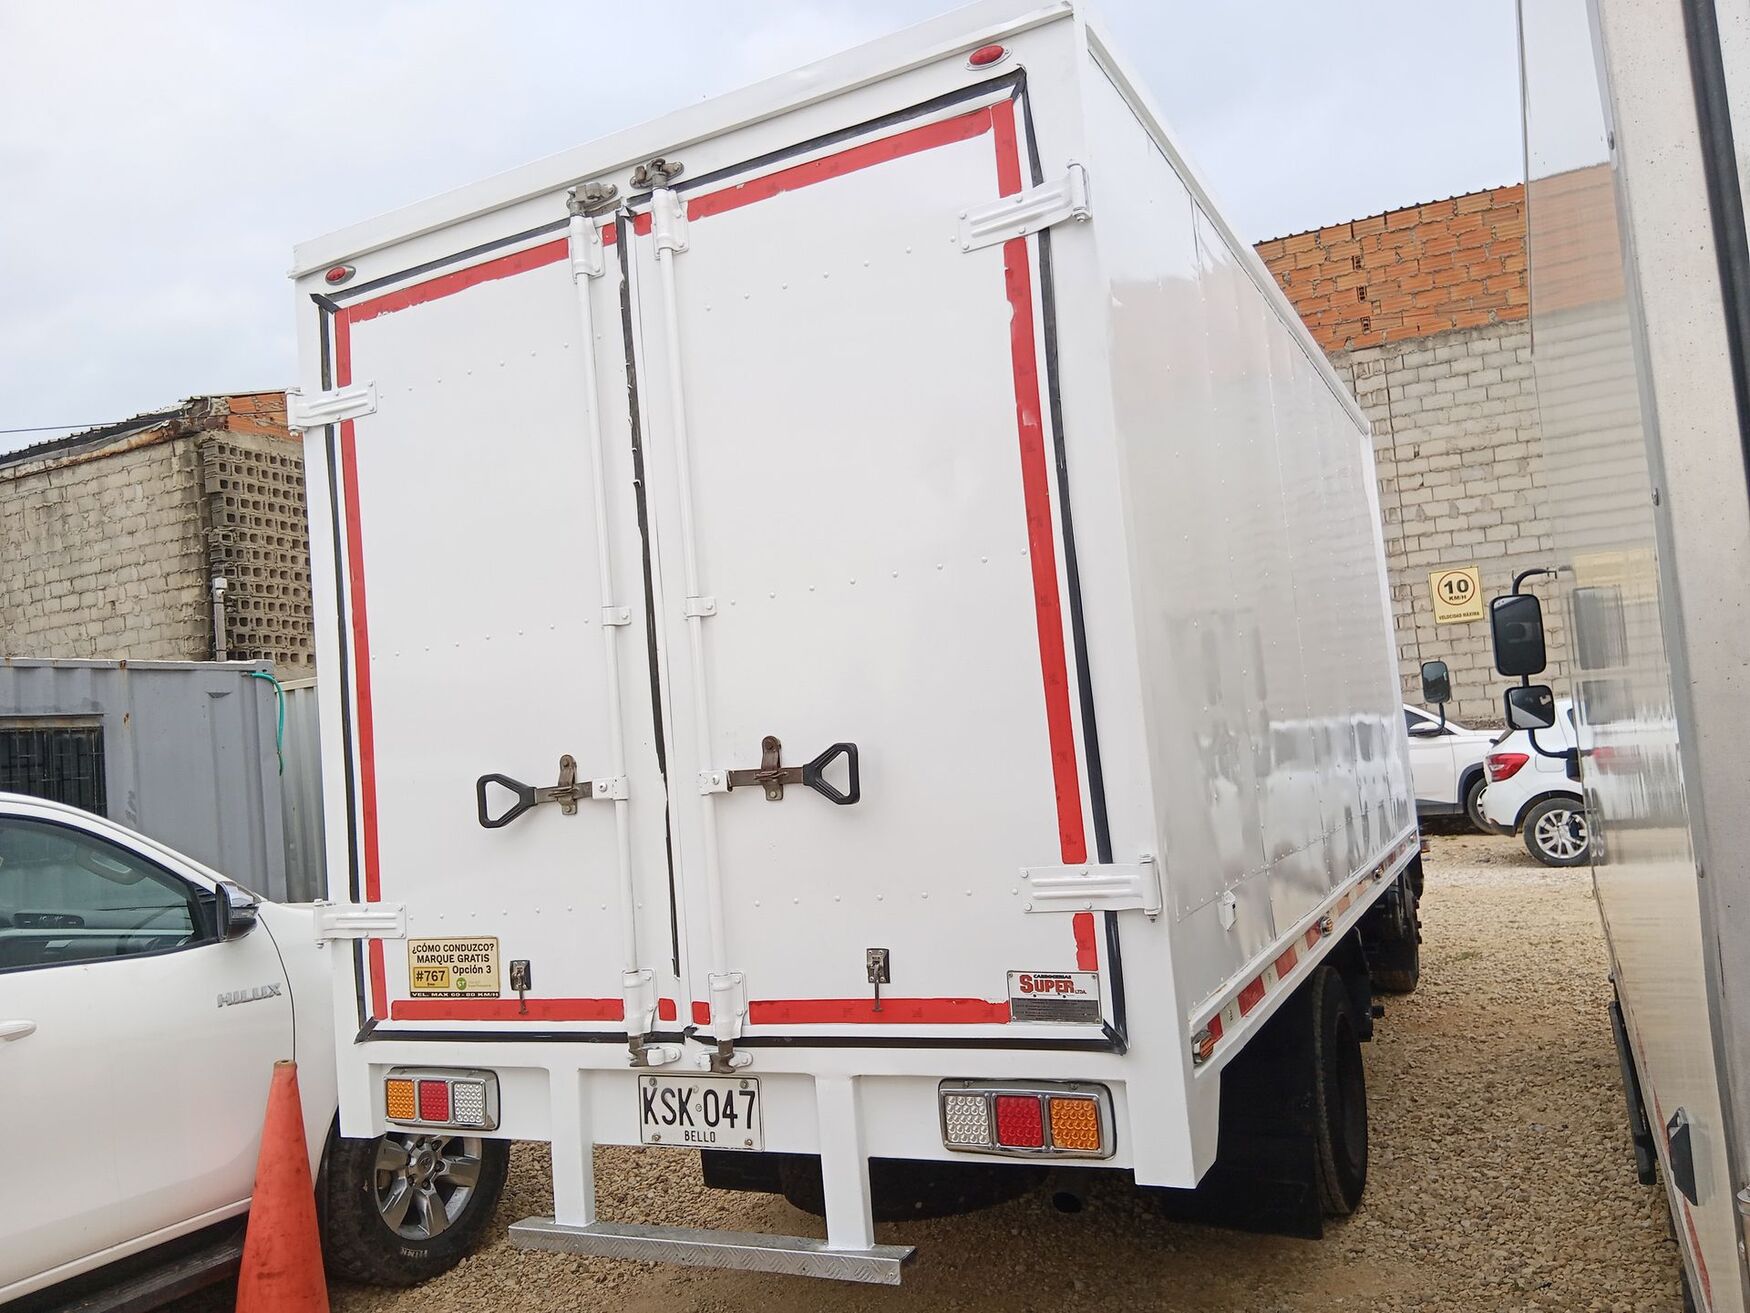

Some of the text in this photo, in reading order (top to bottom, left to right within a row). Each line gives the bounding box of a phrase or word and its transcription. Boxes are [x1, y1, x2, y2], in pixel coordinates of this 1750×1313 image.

[1444, 579, 1469, 594] 10
[412, 943, 495, 954] ¿CÓMO CONDUZCO?
[416, 953, 490, 965] MARQUE GRATIS
[416, 970, 446, 982] #767
[452, 964, 492, 976] Opción 3
[1019, 974, 1074, 993] SUPER
[217, 982, 282, 1008] HILUX
[643, 1086, 756, 1129] KSK 047
[684, 1130, 716, 1143] BELLO
